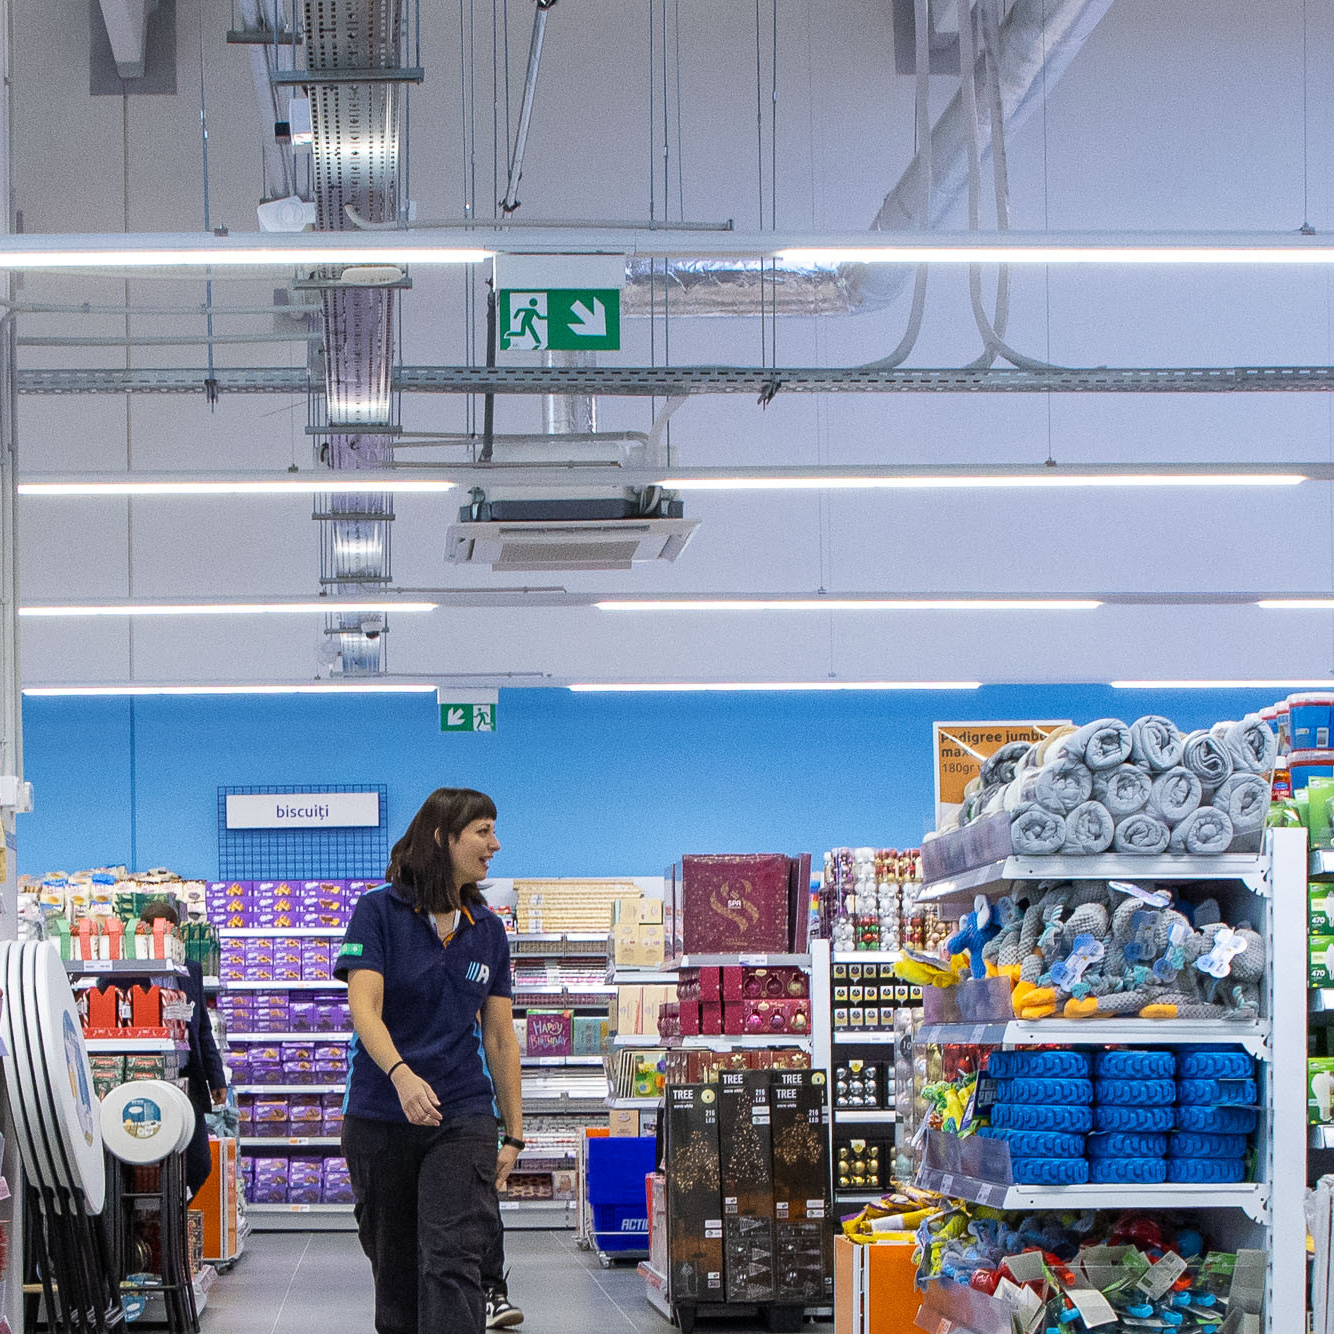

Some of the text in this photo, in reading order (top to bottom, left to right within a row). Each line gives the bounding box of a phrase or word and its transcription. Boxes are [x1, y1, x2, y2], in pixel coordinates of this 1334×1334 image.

[942, 763, 976, 774] 180gr
[276, 803, 329, 820] biscuiți
[533, 1021, 563, 1035] HAPPY
[722, 1073, 744, 1085] TREE
[782, 1073, 802, 1085] TREE
[673, 1090, 693, 1100] TREE
[776, 1089, 797, 1099] TREE
